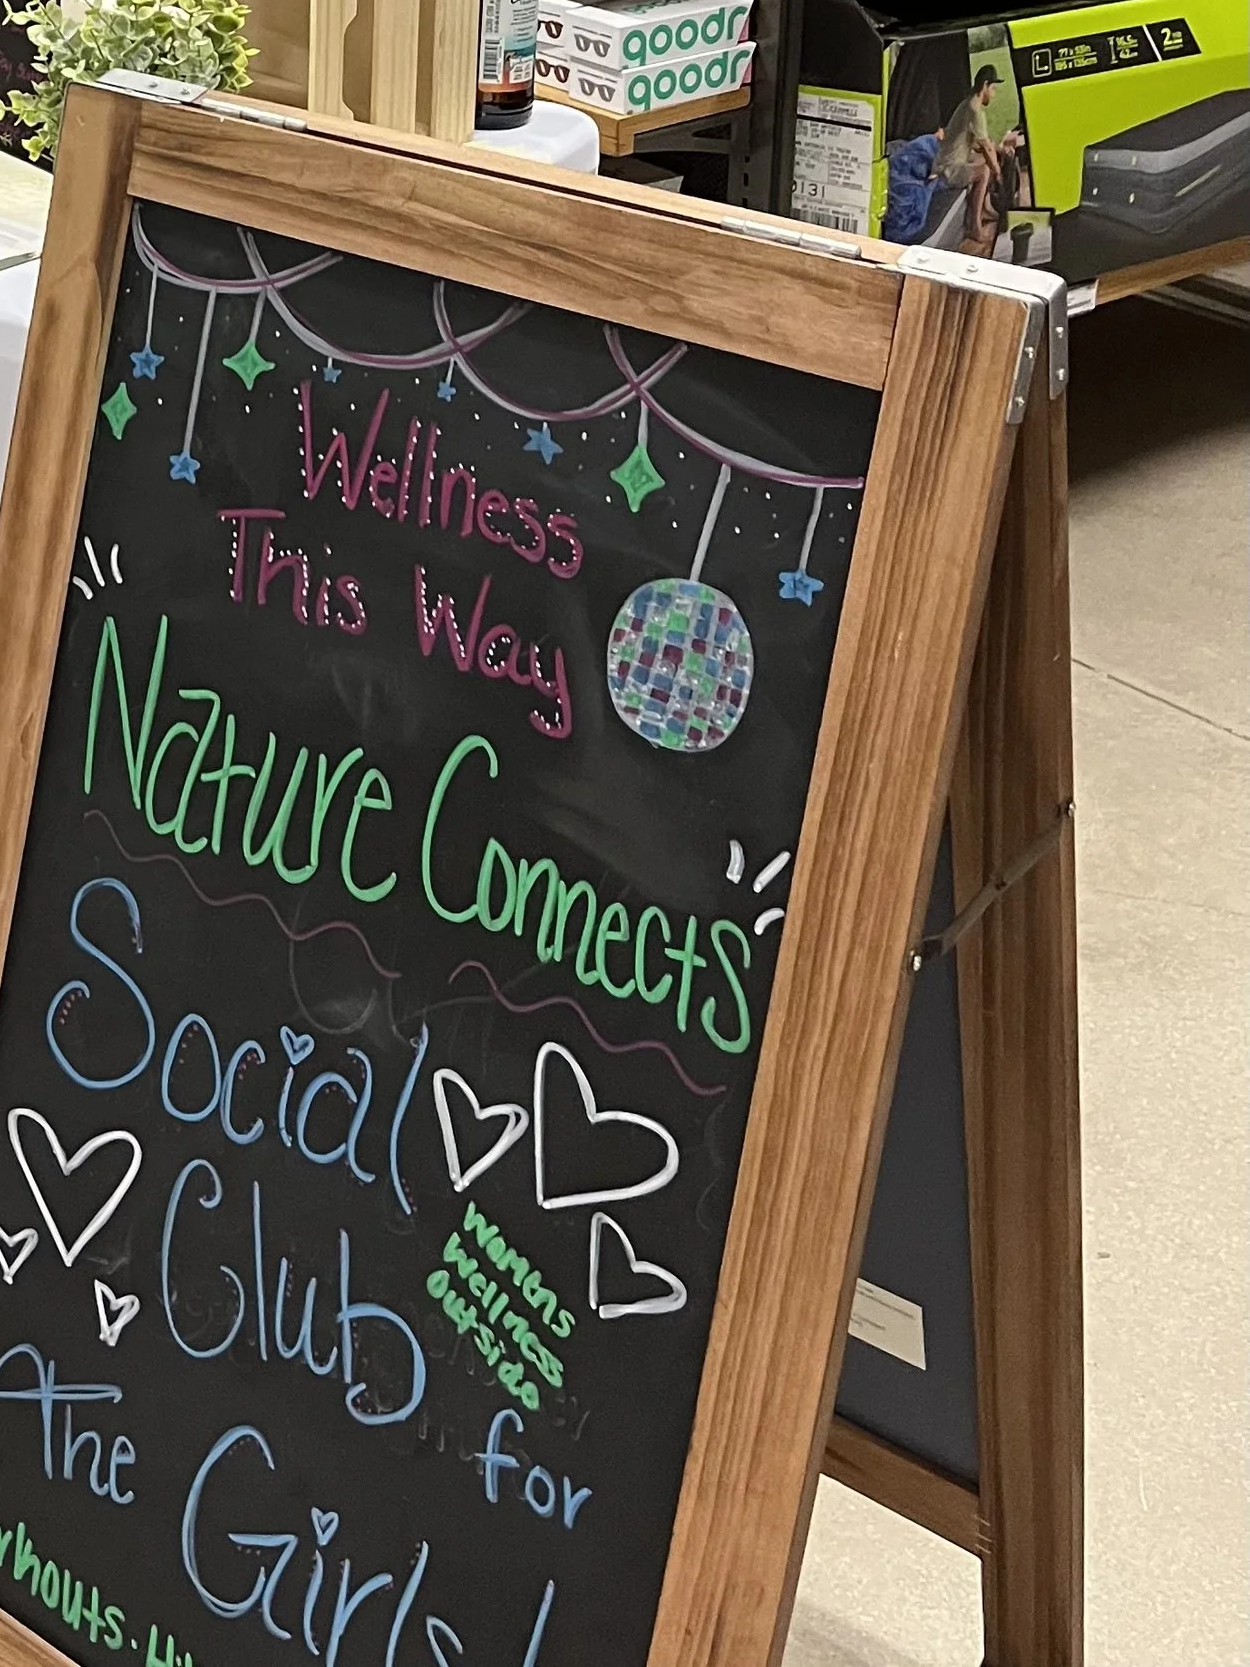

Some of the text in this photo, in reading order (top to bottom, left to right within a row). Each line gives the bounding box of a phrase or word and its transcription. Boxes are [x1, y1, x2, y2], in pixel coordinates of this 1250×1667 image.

[623, 6, 747, 69] goodr
[628, 49, 750, 111] goodr
[298, 381, 584, 578] Wellness
[217, 508, 574, 738] This Way
[84, 614, 751, 1054] Nature Connects
[46, 878, 430, 1216] Social
[161, 1159, 427, 1426] Club
[475, 1409, 593, 1529] for
